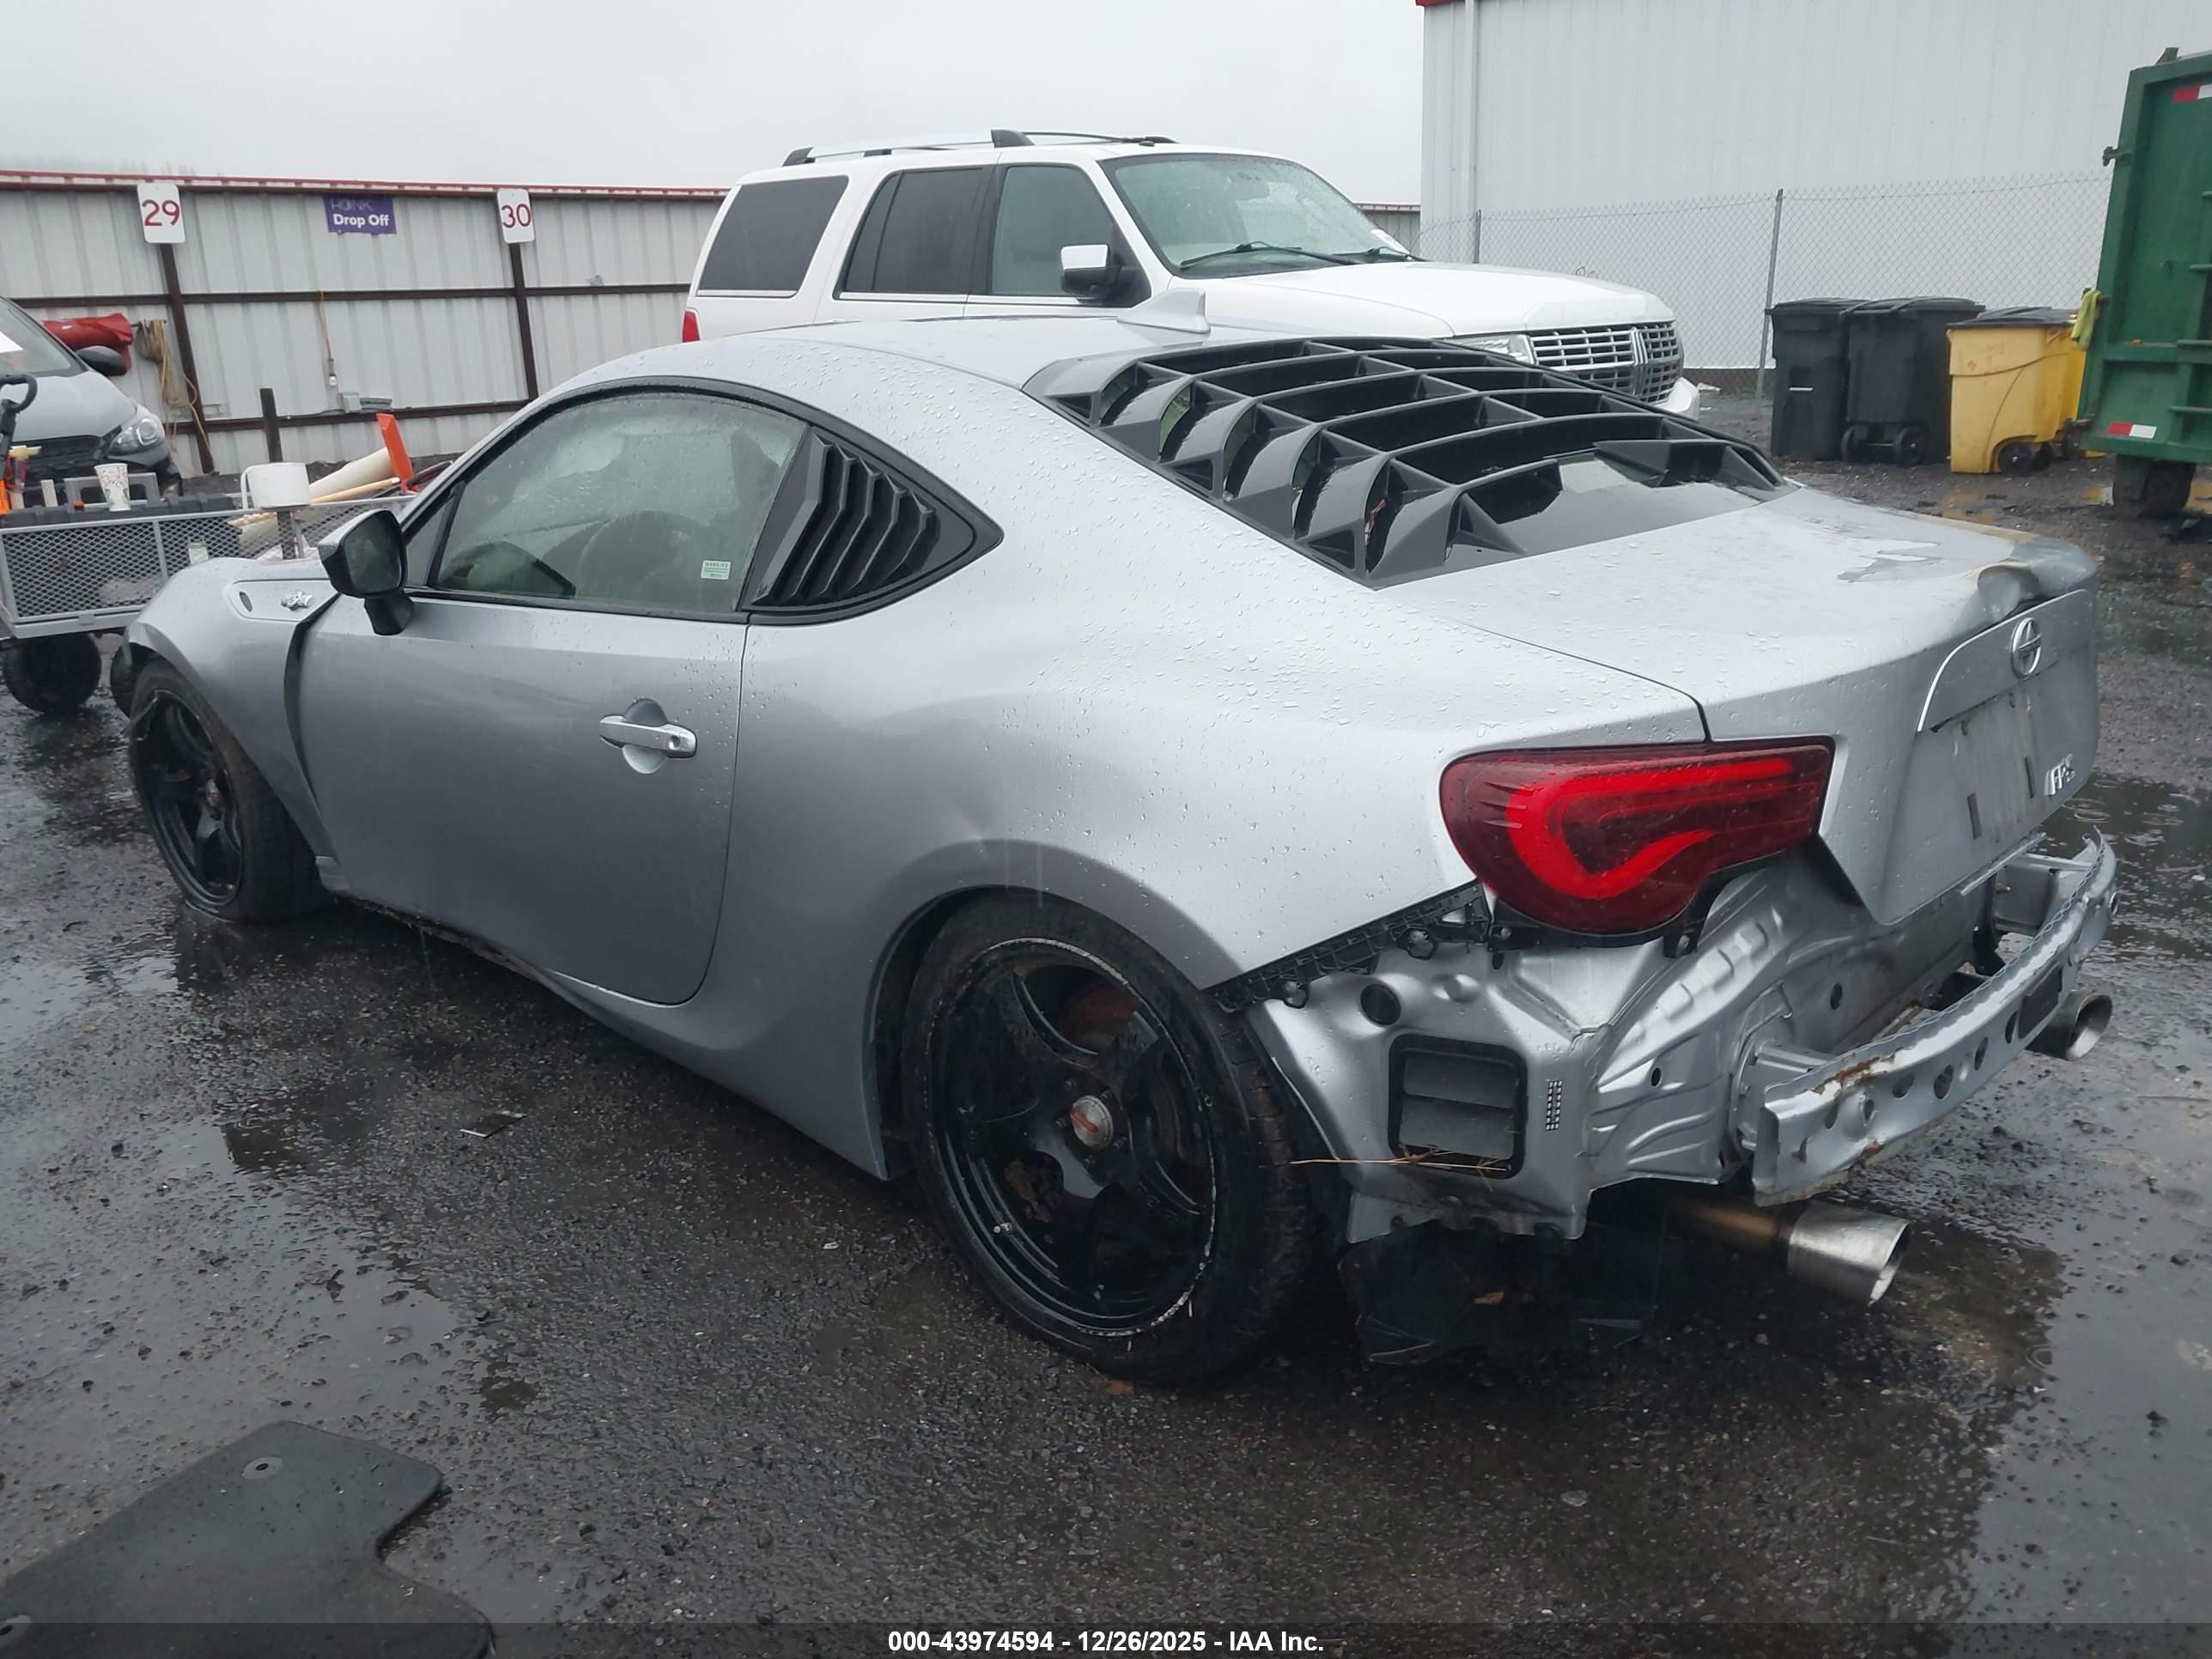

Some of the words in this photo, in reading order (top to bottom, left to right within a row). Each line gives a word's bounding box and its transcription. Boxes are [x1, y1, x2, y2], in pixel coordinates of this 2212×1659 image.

[143, 199, 179, 226] 29
[333, 214, 366, 228] Drop
[368, 215, 389, 226] Off
[501, 204, 531, 228] 30
